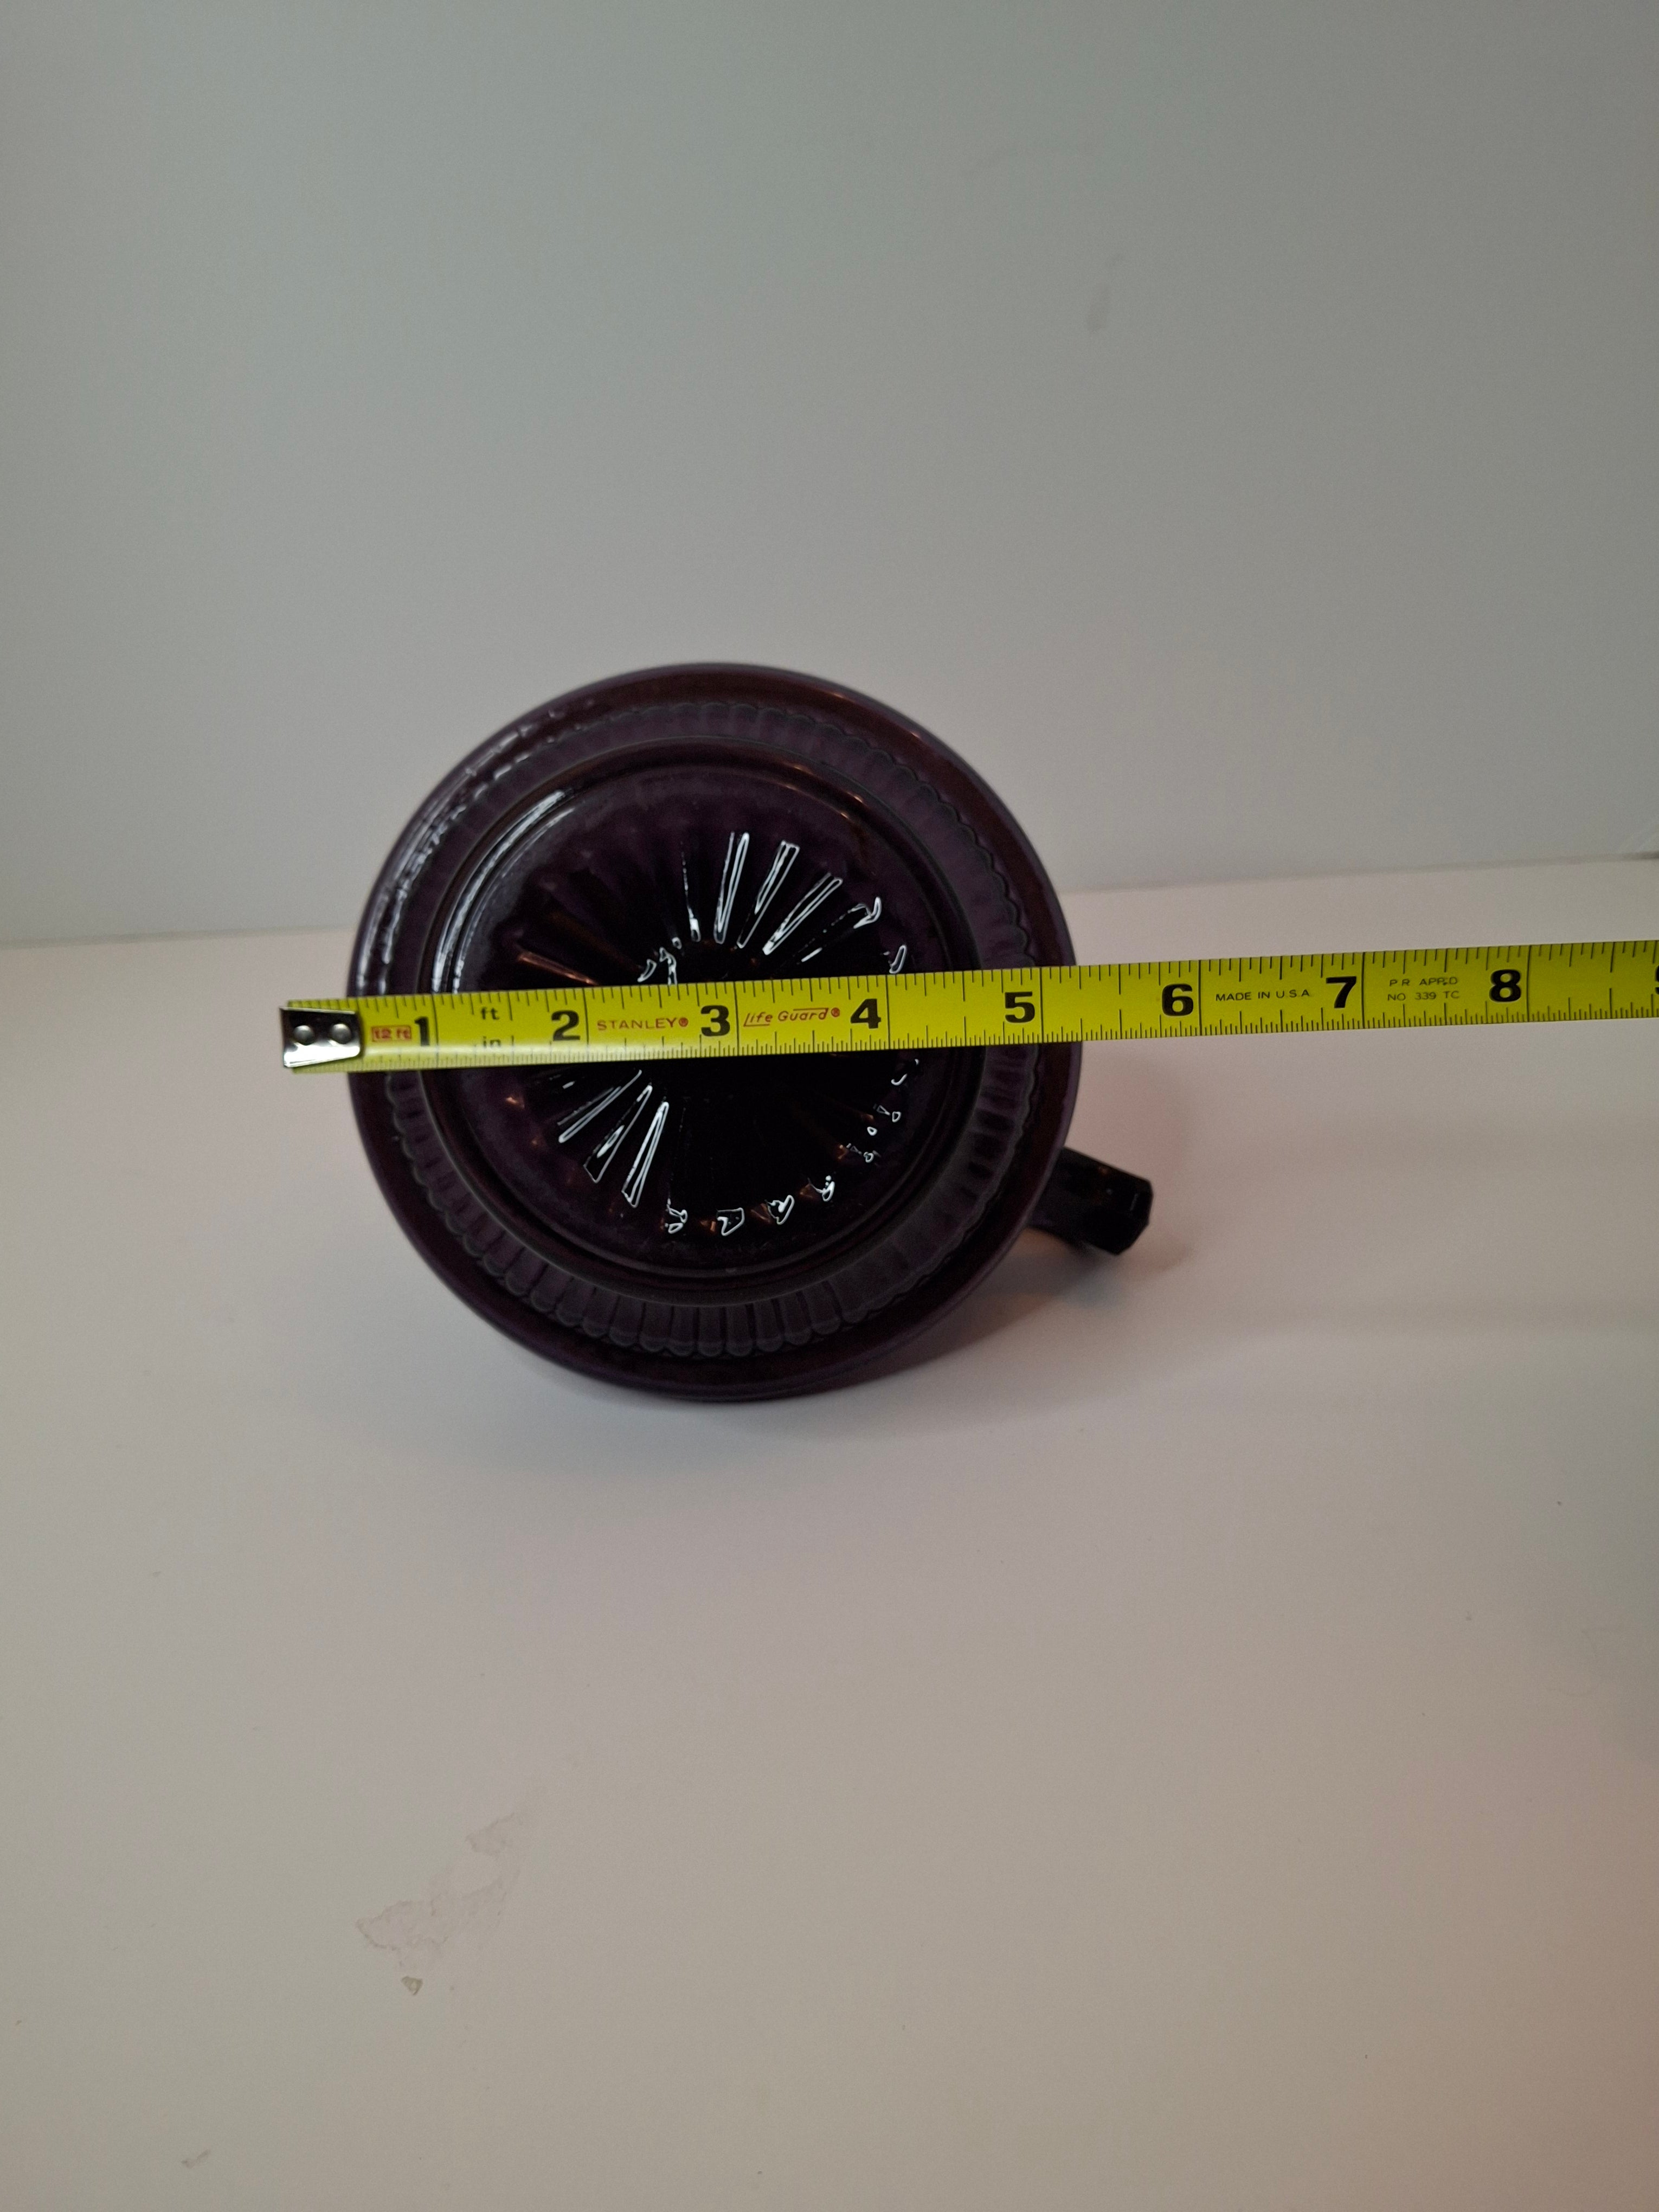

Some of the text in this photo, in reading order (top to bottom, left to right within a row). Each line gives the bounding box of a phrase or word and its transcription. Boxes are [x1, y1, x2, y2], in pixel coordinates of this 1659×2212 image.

[1162, 983, 1193, 1017] 6
[1216, 992, 1251, 1001] MADE
[1258, 991, 1270, 999] IN
[1326, 976, 1357, 1008] 7
[1387, 991, 1459, 1001] NO 339 TC
[1489, 969, 1521, 1002] 8
[481, 1007, 500, 1020] ft
[700, 1005, 730, 1037] 3
[743, 1012, 773, 1027] Life
[850, 998, 882, 1029] 4
[1005, 991, 1036, 1023] 5
[414, 1016, 430, 1046] 1
[551, 1010, 581, 1041] 2
[483, 1036, 501, 1048] in
